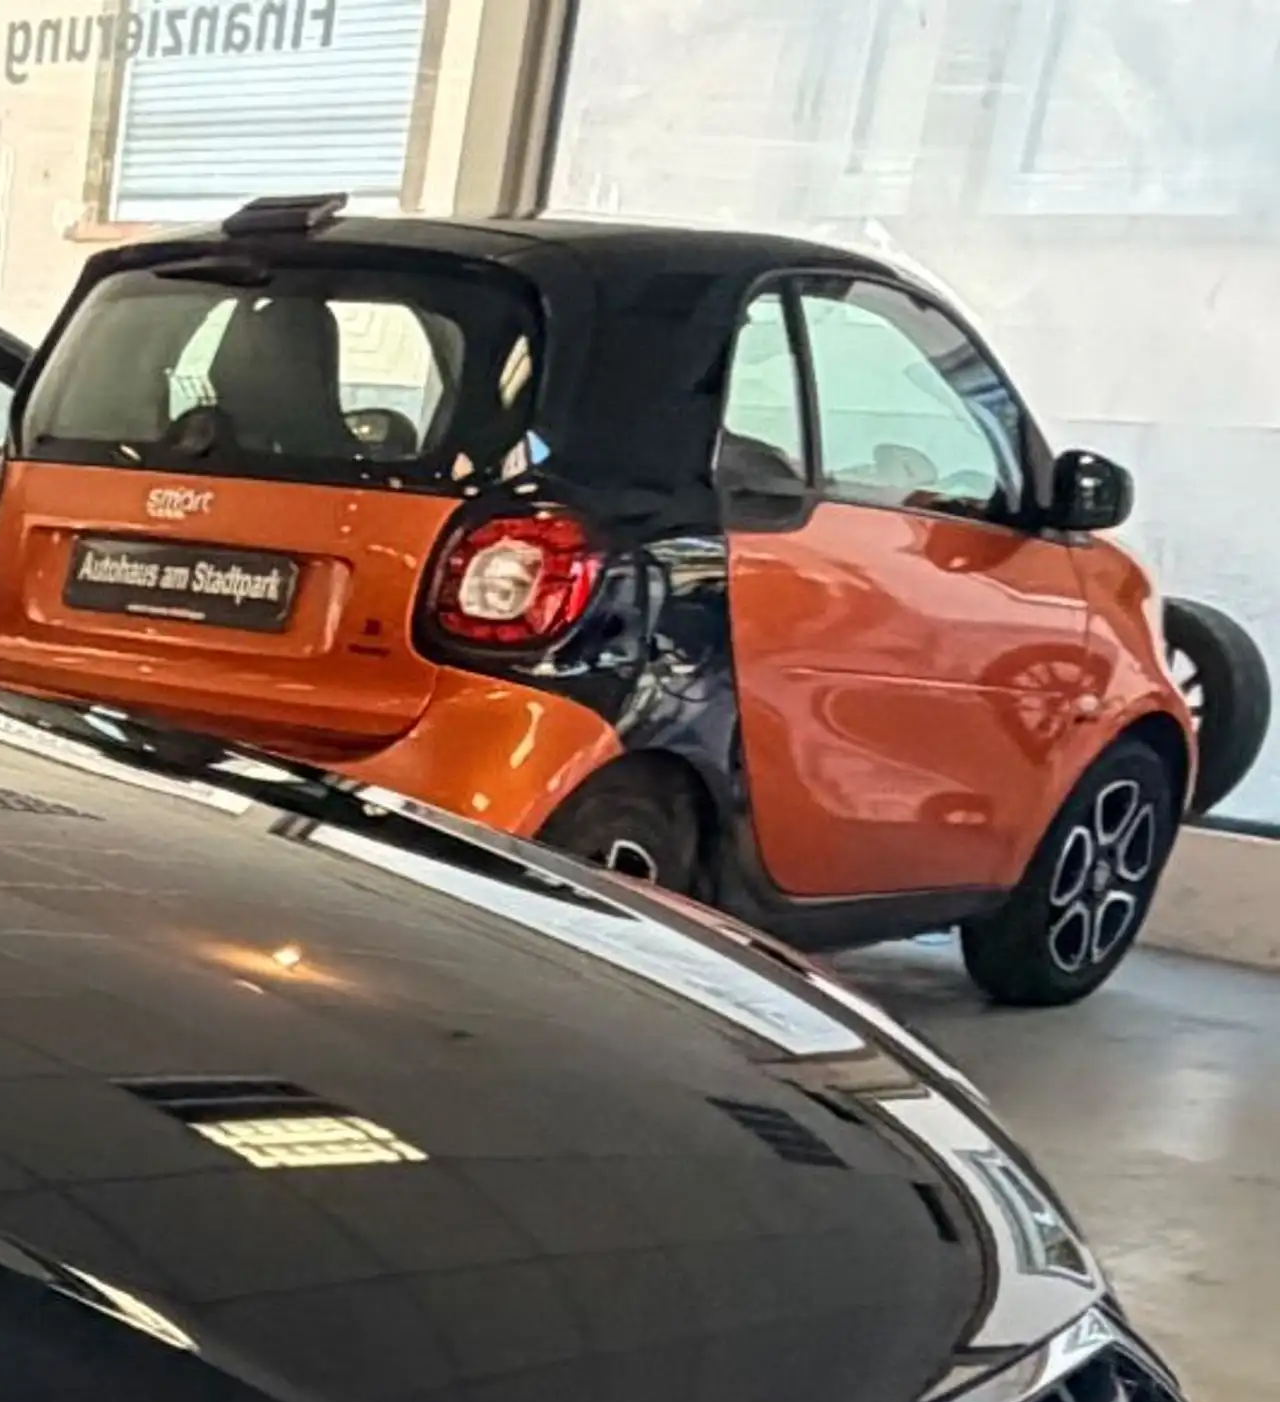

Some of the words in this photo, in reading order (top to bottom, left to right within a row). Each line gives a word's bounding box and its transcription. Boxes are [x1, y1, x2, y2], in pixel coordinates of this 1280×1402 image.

[146, 487, 215, 514] smart
[77, 551, 159, 587] Autohaus
[160, 565, 191, 590] am
[192, 561, 282, 605] Stadtpark
